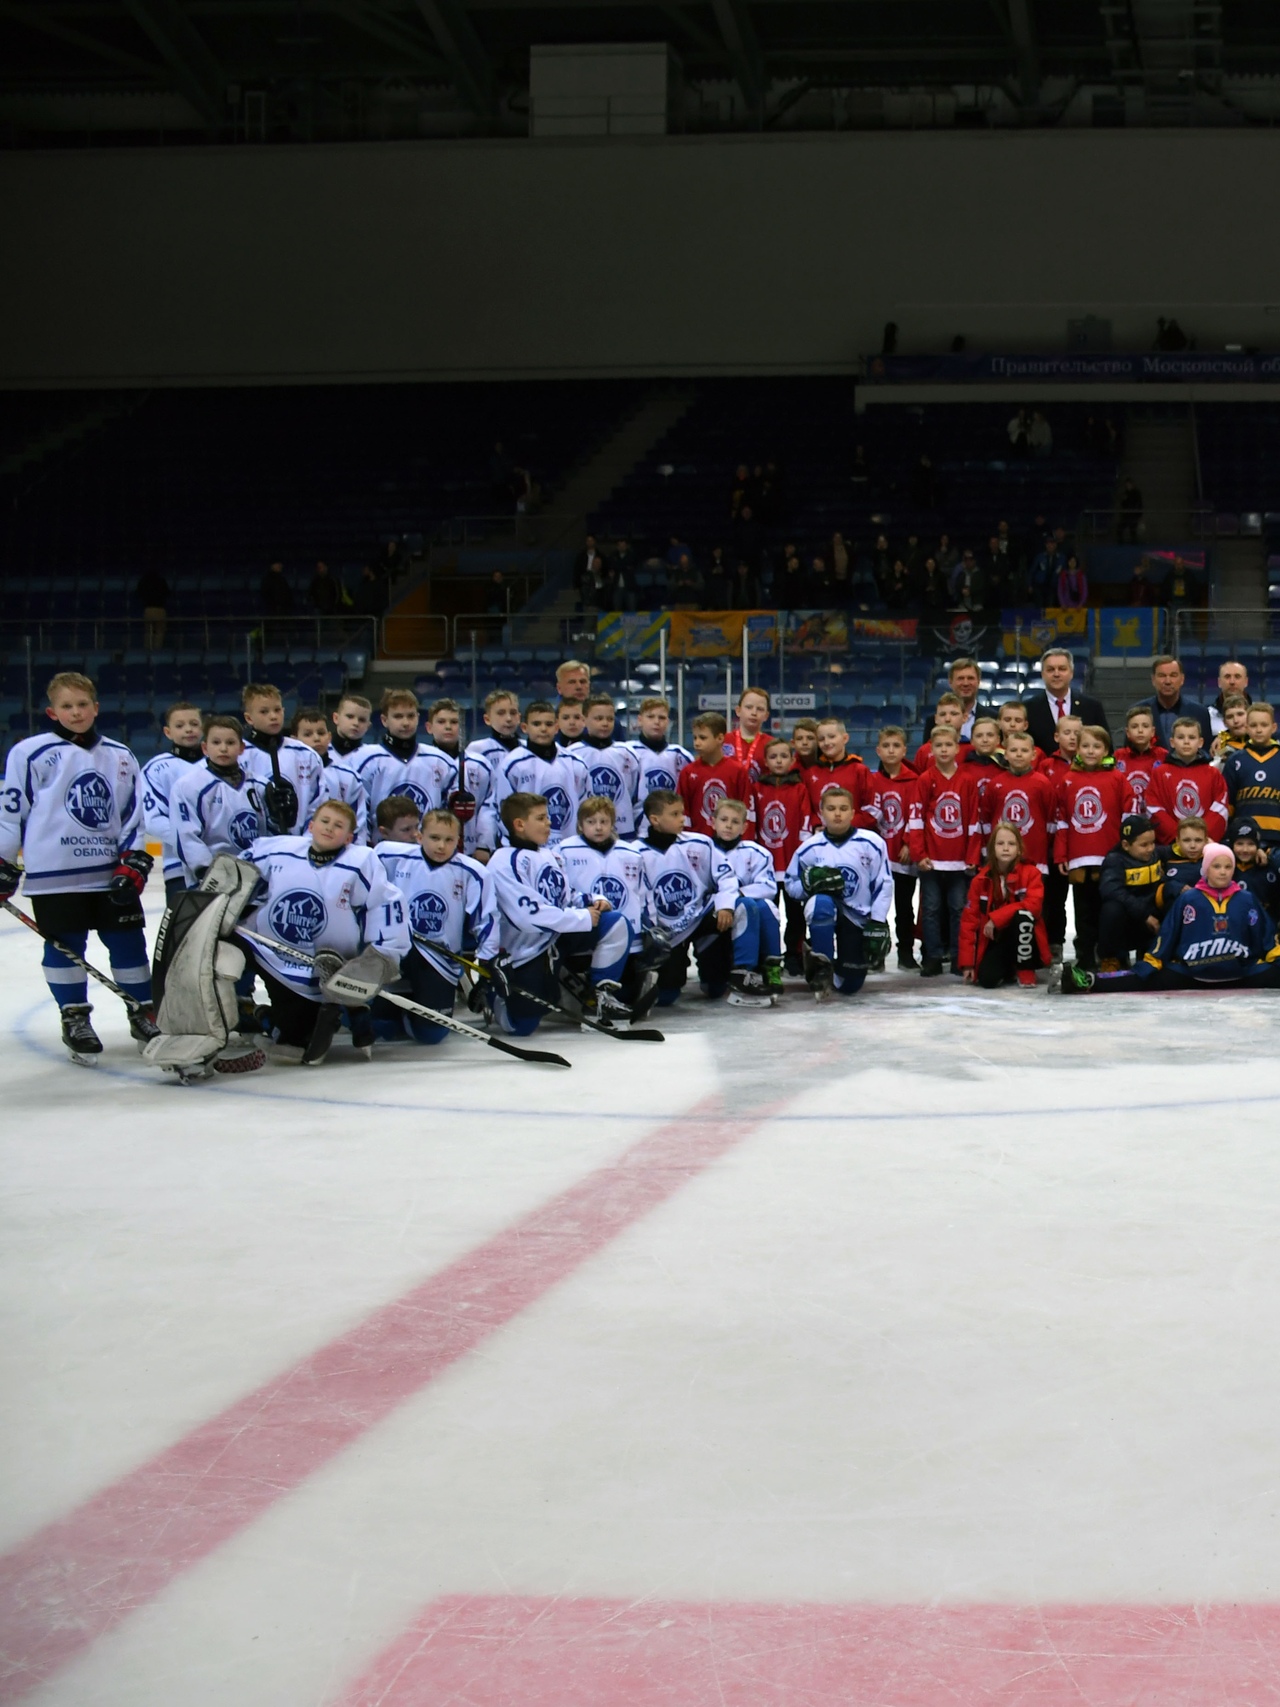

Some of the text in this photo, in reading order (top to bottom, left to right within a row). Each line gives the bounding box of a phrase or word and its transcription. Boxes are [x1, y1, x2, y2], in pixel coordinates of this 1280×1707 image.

[990, 357, 1132, 376] Правительство
[1144, 356, 1254, 373] Московской
[0, 788, 22, 813] 3
[382, 901, 403, 926] 73
[517, 895, 540, 915] 3
[155, 907, 174, 962] BAUER
